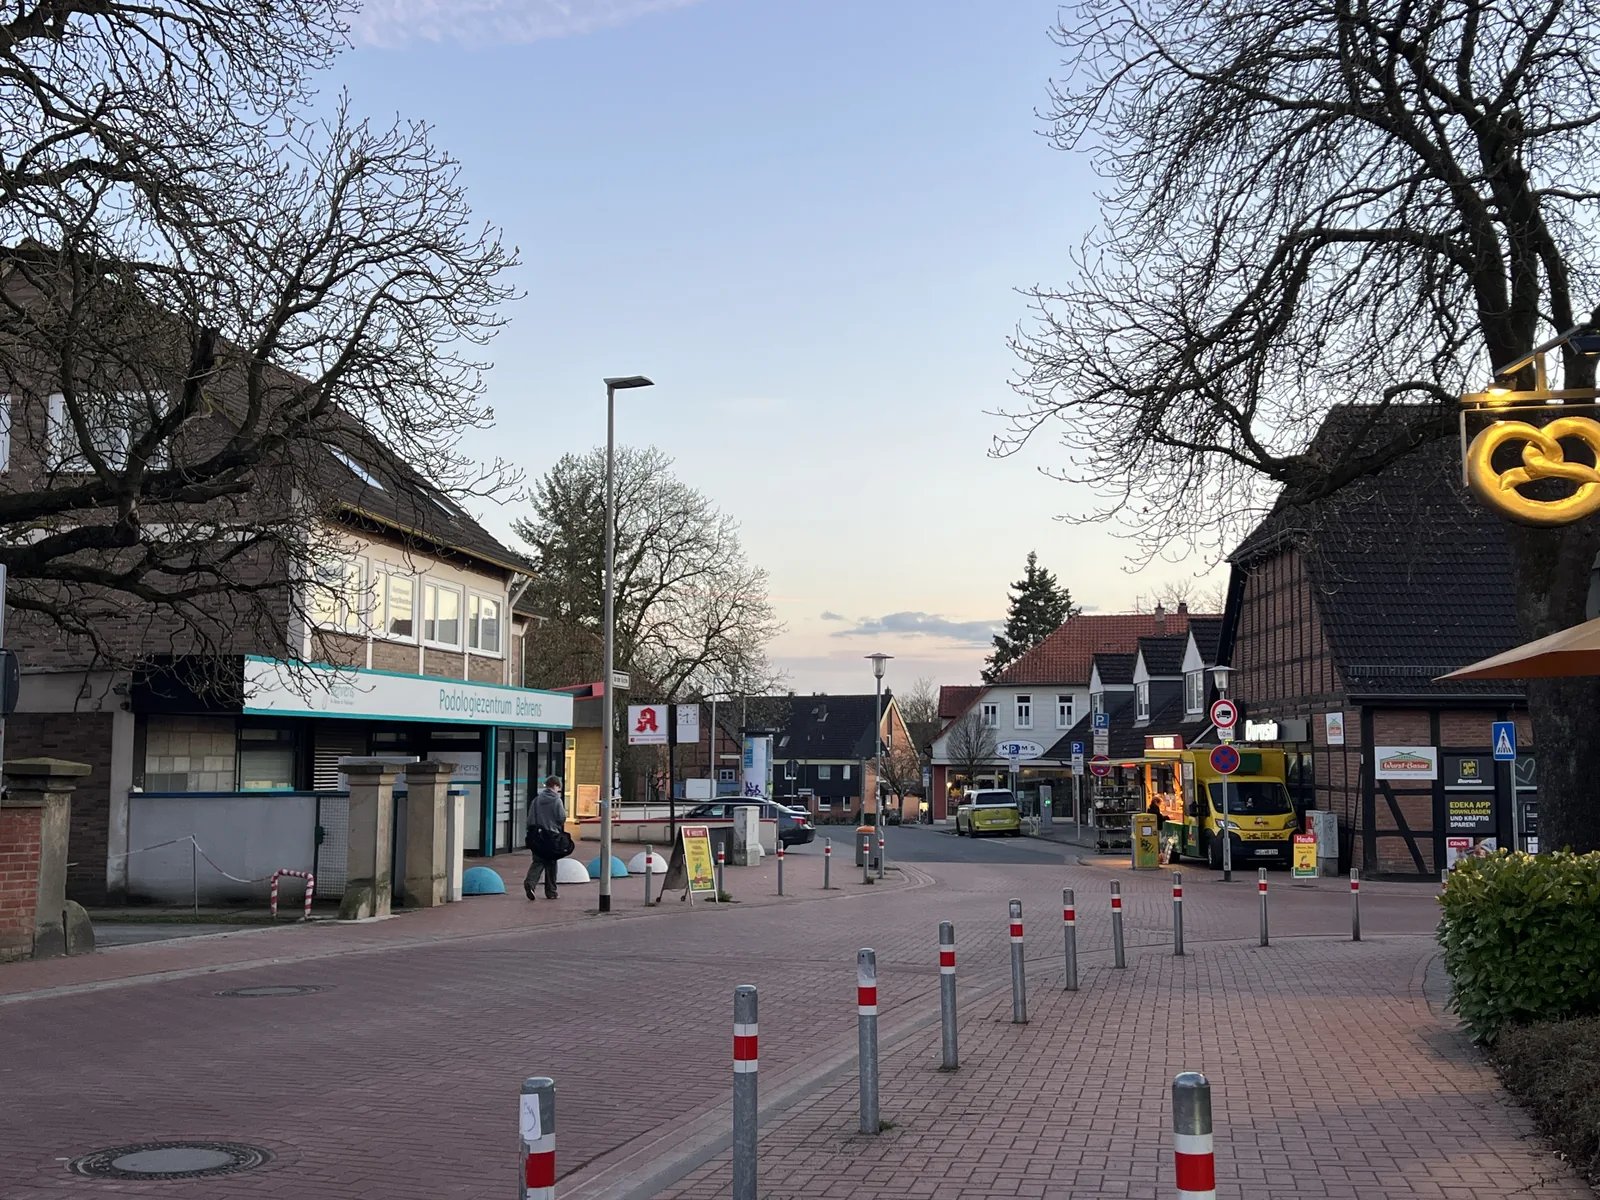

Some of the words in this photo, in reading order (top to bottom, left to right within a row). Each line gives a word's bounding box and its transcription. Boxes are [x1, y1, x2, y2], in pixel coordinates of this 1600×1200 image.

[439, 689, 512, 718] Podologiezentrum
[516, 697, 542, 717] Behrens
[1073, 743, 1080, 753] P
[1449, 801, 1475, 809] EDEKA
[1475, 801, 1492, 809] APP
[1463, 814, 1490, 822] KRÄFTIG
[1296, 835, 1315, 844] Heute
